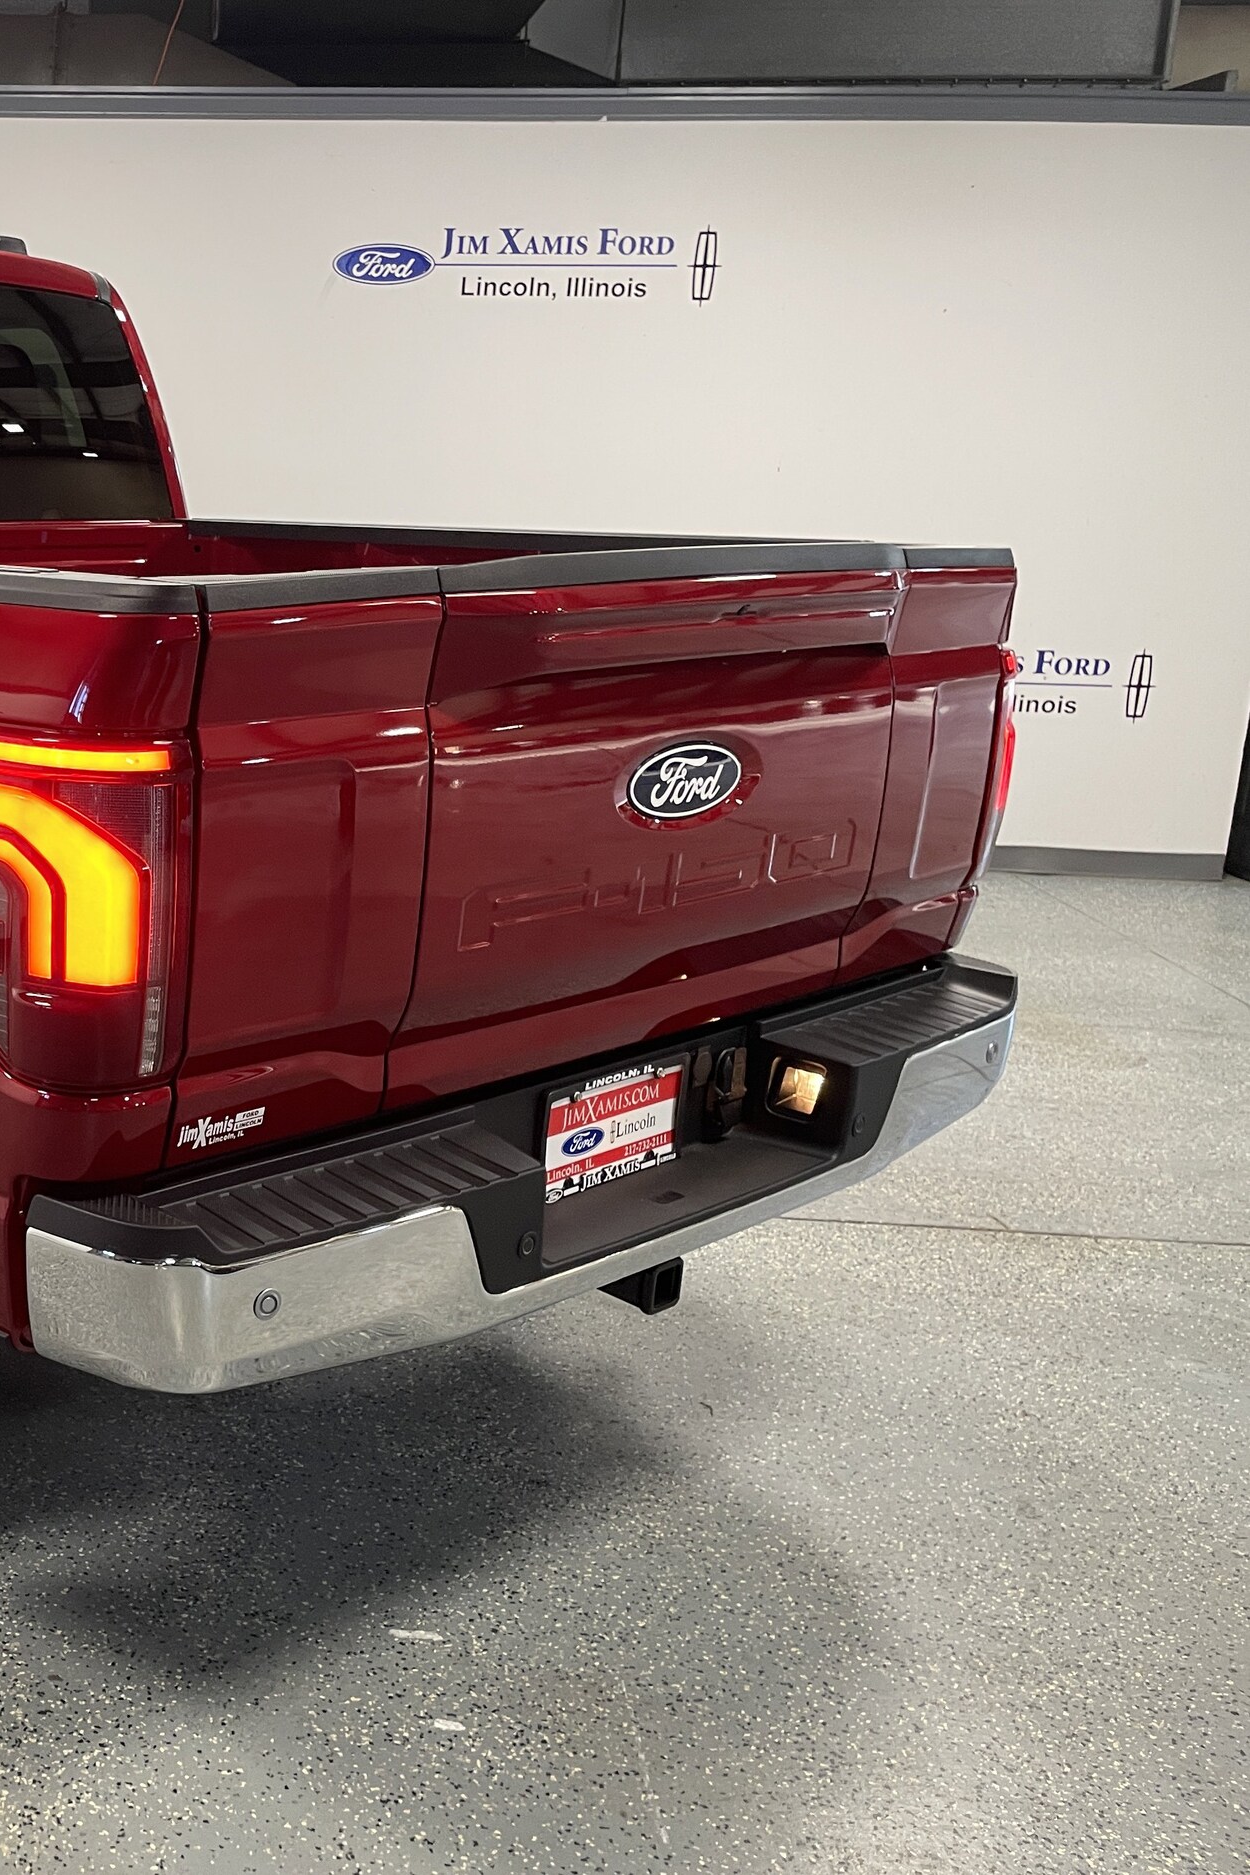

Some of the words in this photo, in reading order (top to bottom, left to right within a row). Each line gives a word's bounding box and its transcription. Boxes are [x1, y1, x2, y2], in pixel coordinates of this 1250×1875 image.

[441, 228, 490, 259] JIM
[497, 228, 588, 256] XAMIS
[596, 228, 675, 256] FORD
[461, 276, 556, 301] Lincoln,
[566, 277, 647, 298] Illinois
[1033, 649, 1111, 676] FORD
[1012, 694, 1077, 714] linois
[650, 755, 724, 808] Ford
[585, 1068, 640, 1091] LINCOLN,
[643, 1064, 655, 1074] IL
[616, 1112, 657, 1138] Lincoln
[585, 1158, 595, 1170] IL
[623, 1133, 668, 1157] 217-732-2111
[580, 1173, 603, 1192] JIM
[602, 1160, 642, 1181] XAMIS
